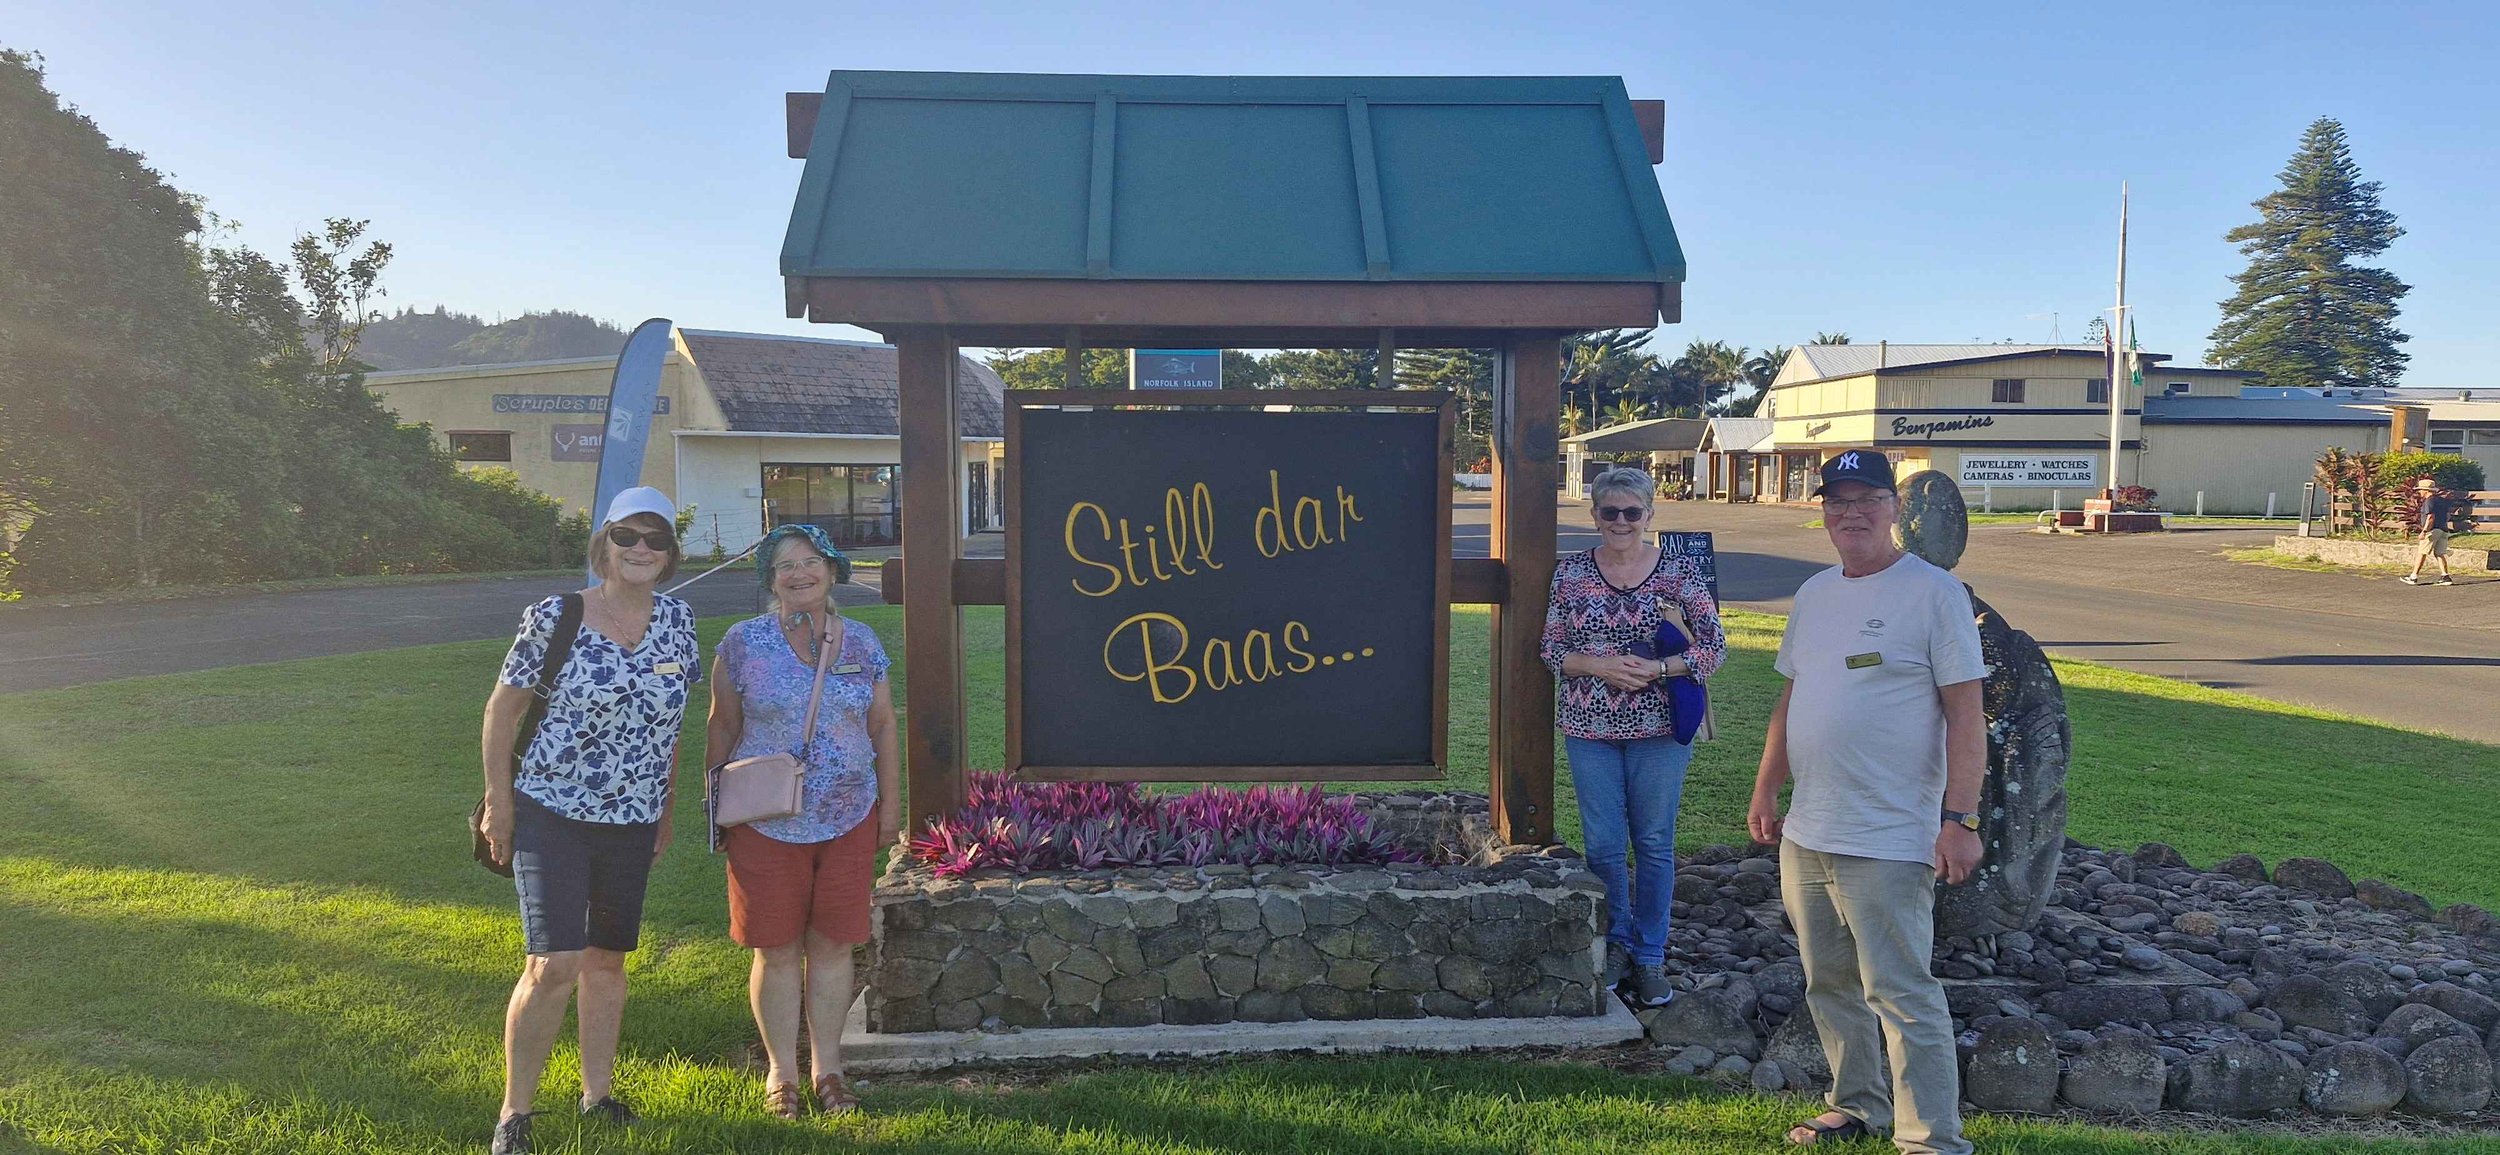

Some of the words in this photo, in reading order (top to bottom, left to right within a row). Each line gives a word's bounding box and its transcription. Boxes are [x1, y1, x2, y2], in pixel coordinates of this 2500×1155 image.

[1144, 380, 1179, 388] NORFOLK
[1184, 380, 1214, 388] ISLAND
[1892, 415, 1994, 439] Benjamins
[1838, 452, 1859, 471] NY
[1966, 460, 2028, 469] JEWELLERY
[2041, 460, 2089, 469] WATCHES
[1963, 472, 2014, 481] CAMERAS
[2027, 472, 2091, 481] BINOCULARS
[1065, 482, 1224, 597] Still
[1255, 469, 1363, 558] dar
[1660, 534, 1685, 554] BAR
[1104, 612, 1374, 703] Baas...
